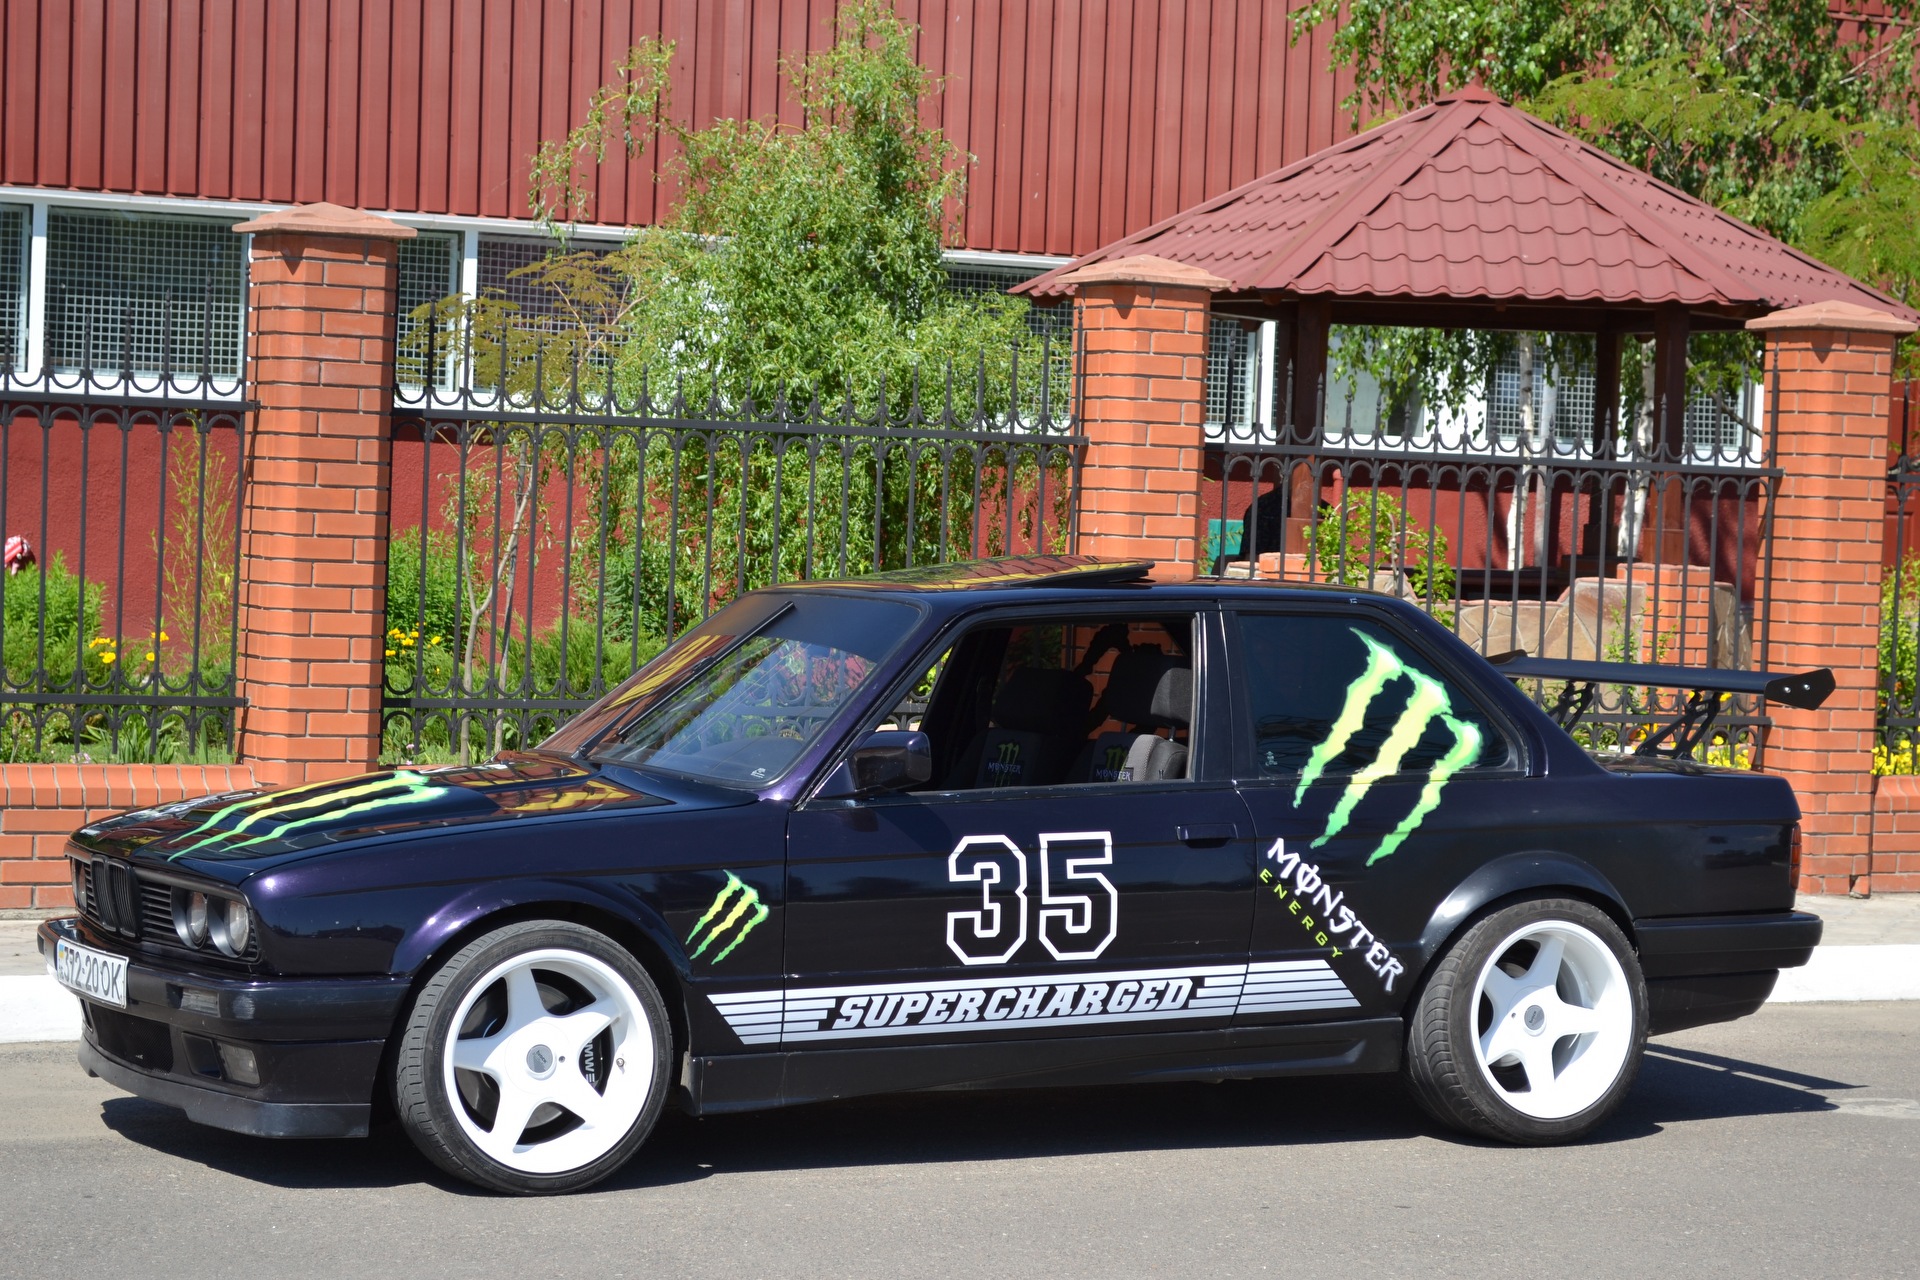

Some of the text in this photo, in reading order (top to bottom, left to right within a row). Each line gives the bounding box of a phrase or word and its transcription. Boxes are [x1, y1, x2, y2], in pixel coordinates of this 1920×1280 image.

[947, 831, 1118, 966] 35
[1259, 868, 1343, 958] ENERGY
[832, 978, 1194, 1030] SUPERCHARGED
